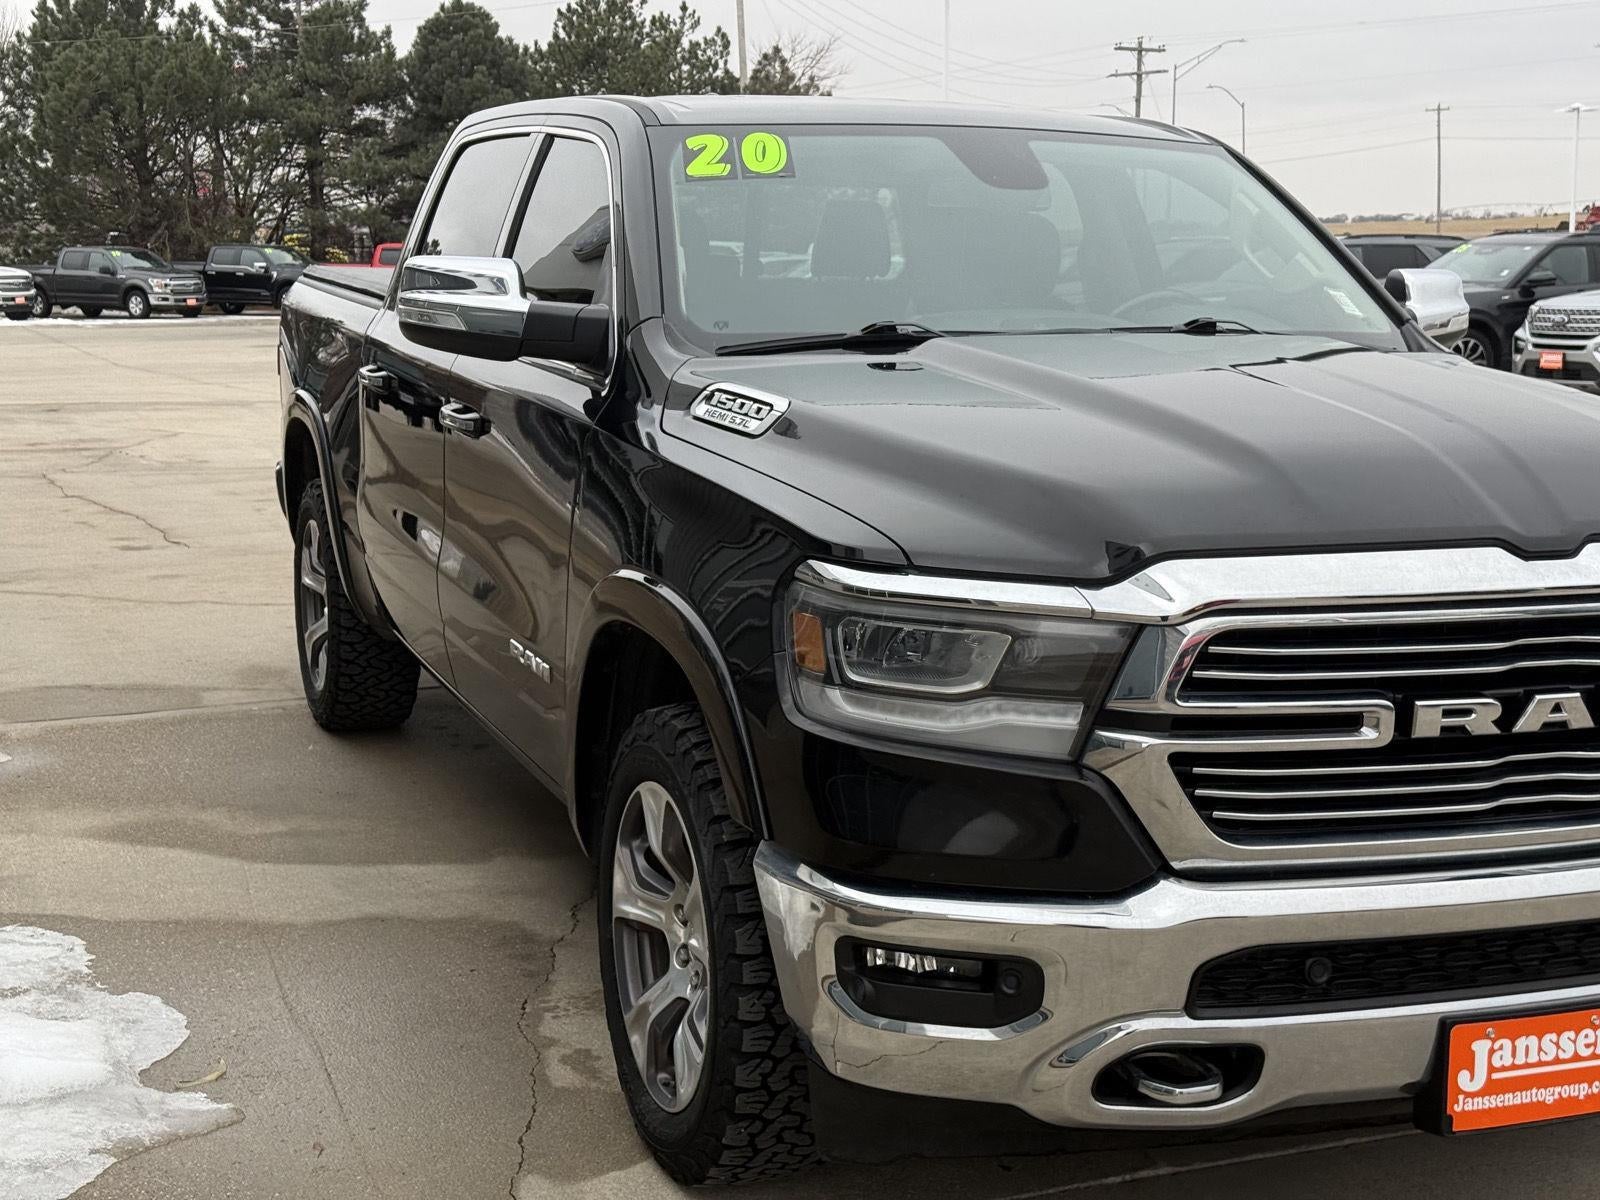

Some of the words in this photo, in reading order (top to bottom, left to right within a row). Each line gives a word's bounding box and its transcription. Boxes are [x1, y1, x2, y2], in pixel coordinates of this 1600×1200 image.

[685, 132, 788, 177] 20
[704, 407, 729, 422] HEMI
[729, 416, 750, 429] 5.7L
[711, 391, 771, 419] 1500
[509, 638, 551, 685] RAM
[1457, 1028, 1600, 1092] Jansse
[1454, 1080, 1600, 1112] Janssenautogroup.c
